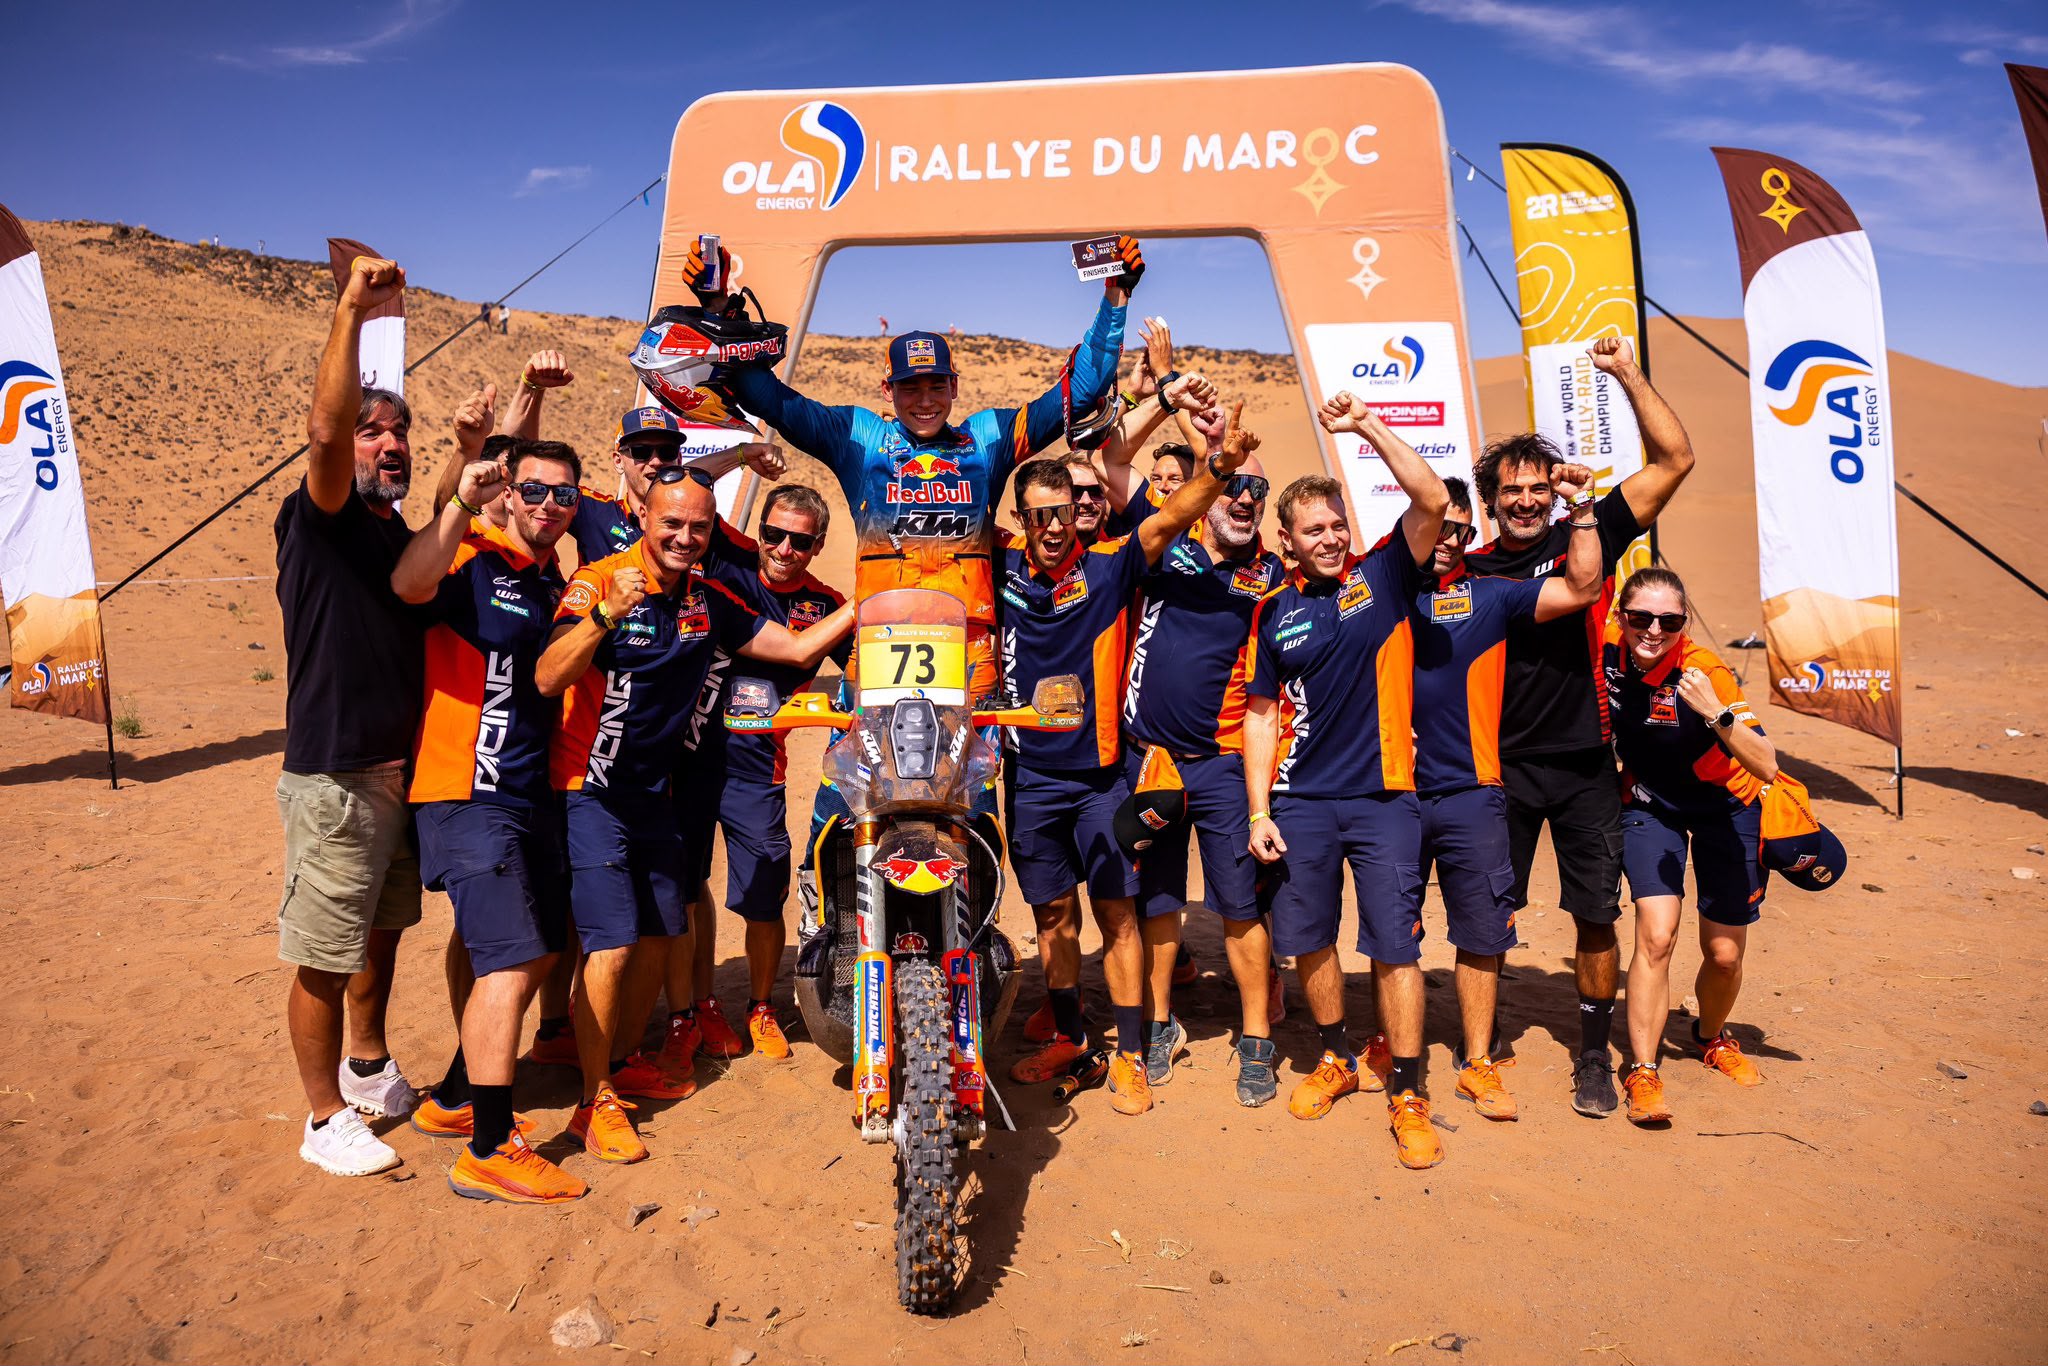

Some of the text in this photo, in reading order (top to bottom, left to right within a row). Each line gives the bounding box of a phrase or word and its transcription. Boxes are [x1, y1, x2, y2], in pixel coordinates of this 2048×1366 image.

[889, 139, 1072, 183] RALLYE
[1092, 134, 1162, 176] DU
[722, 161, 816, 194] OLA
[756, 197, 815, 210] ENERGY
[1082, 252, 1093, 260] OLA
[1082, 266, 1109, 278] FINISHER
[1352, 363, 1400, 378] OLA
[1560, 365, 1574, 413] WORLD
[1371, 405, 1440, 416] IMOINSA
[1575, 356, 1597, 457] RALLY-RAID
[1595, 370, 1613, 455] CHAMPIONS
[1864, 385, 1880, 446] ENERGY
[51, 397, 68, 453] ENERGY
[1826, 386, 1864, 484] OLA
[25, 398, 59, 491] OLA
[886, 480, 973, 504] Red Bull
[896, 510, 969, 537] KTM
[1170, 560, 1196, 575] WP
[1534, 553, 1567, 578] WP
[1060, 587, 1082, 599] KTM
[1237, 579, 1262, 590] KTM
[495, 589, 522, 600] WP
[1004, 590, 1028, 609] MOTOREX
[1345, 589, 1365, 603] KTM
[500, 602, 529, 617] MOTOREX
[677, 602, 707, 617] Red Bull
[1056, 602, 1073, 611] FACTORY
[1341, 598, 1373, 618] FACTORY RACING
[1439, 601, 1465, 611] KTM
[686, 619, 704, 628] KTM
[790, 609, 822, 623] Red Bull
[1453, 612, 1471, 620] RACING
[629, 623, 653, 633] MOTOREX
[1281, 621, 1310, 638] MOTOREX
[627, 636, 651, 646] WP
[1283, 634, 1309, 651] WP
[57, 661, 88, 675] RALLYE
[890, 643, 936, 685] 73
[1123, 596, 1164, 725] RACING
[1832, 669, 1891, 678] RALLYE DU
[22, 679, 42, 692] OLA
[1779, 677, 1811, 688] OLA
[684, 645, 732, 751] RACIN
[732, 695, 769, 708] Red Bull
[474, 651, 513, 792] RACING
[585, 670, 632, 789] RACING
[731, 719, 769, 728] MOTOREX
[859, 729, 882, 765] KTM
[949, 724, 968, 764] KTM
[1139, 745, 1156, 785] RACING
[1782, 788, 1818, 829] FACTORY RACING
[869, 967, 879, 1040] MICHELIN
